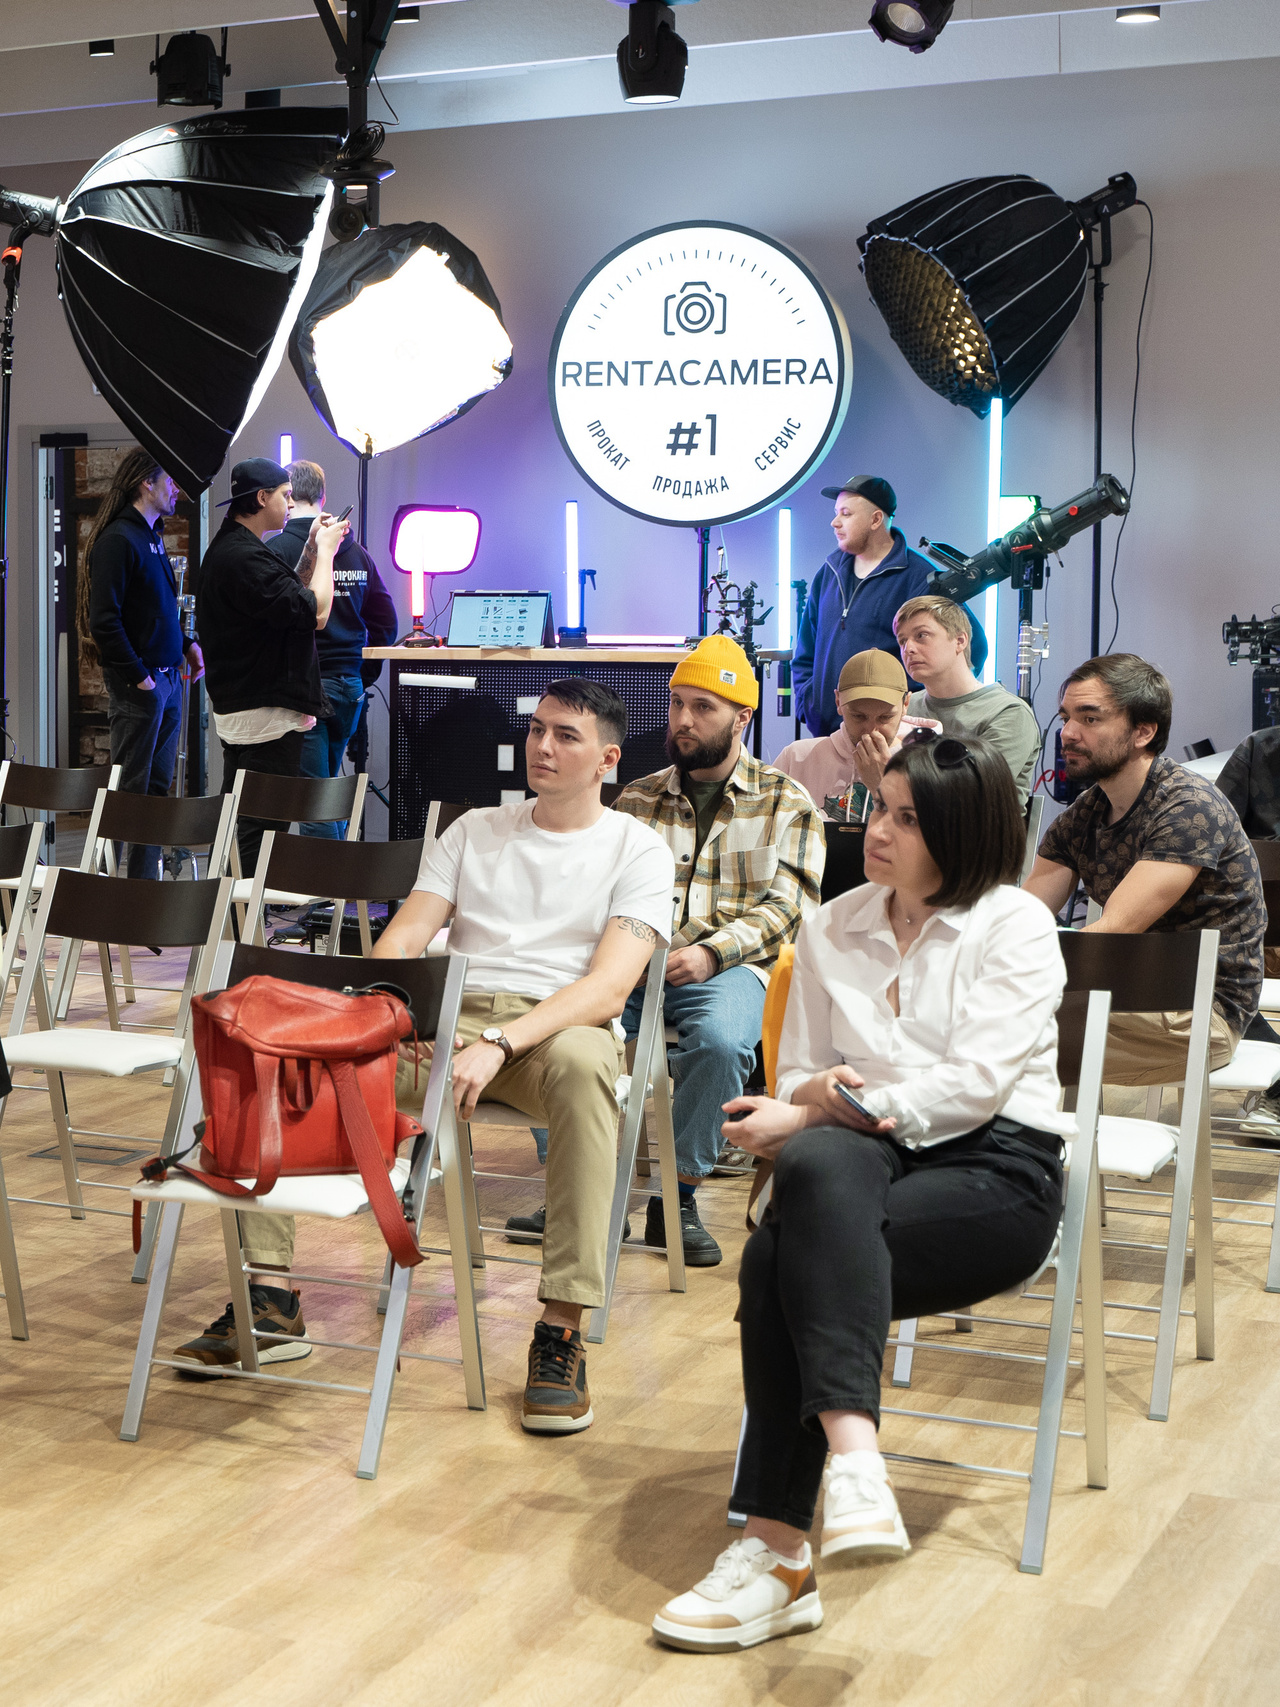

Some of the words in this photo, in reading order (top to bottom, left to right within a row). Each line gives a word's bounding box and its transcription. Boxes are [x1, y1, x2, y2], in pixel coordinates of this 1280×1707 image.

[561, 358, 834, 387] RENTACAMERA
[586, 419, 630, 471] ПРОКАТ
[666, 414, 717, 456] #1
[754, 417, 801, 471] СЕРВИС
[652, 475, 729, 498] ПРОДАЖА
